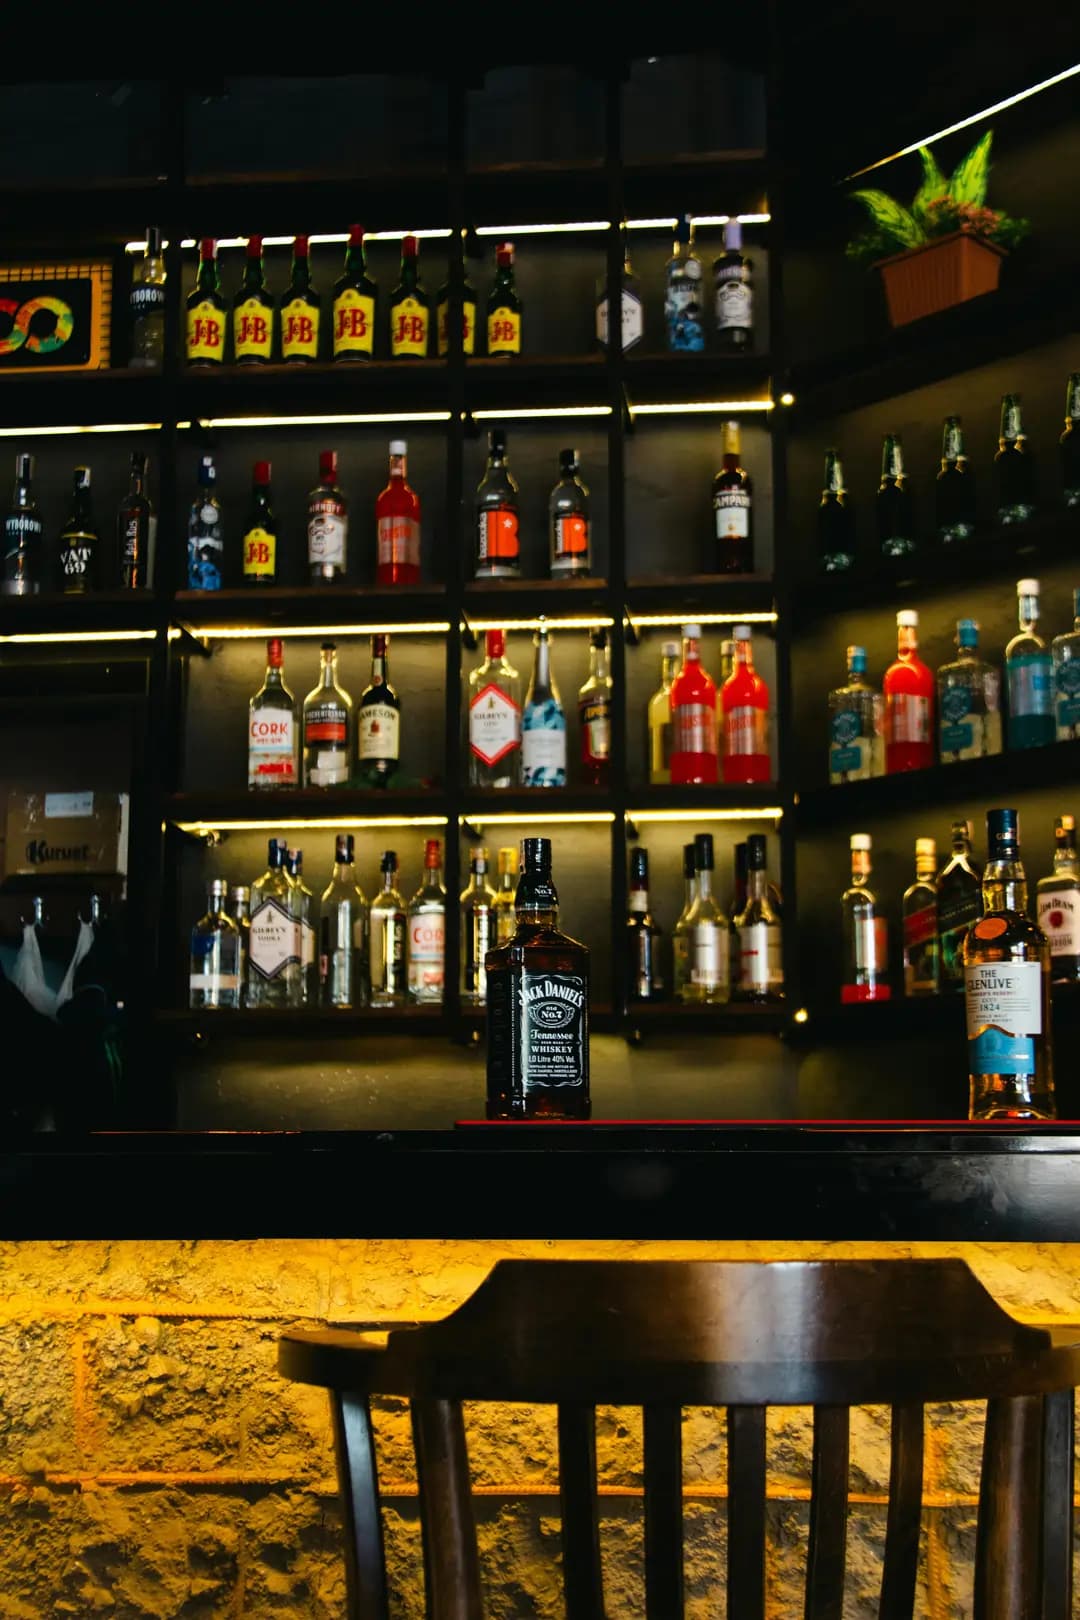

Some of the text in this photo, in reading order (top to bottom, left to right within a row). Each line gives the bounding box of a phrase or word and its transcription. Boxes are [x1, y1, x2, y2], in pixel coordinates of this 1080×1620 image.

[191, 319, 220, 347] J&B
[237, 316, 267, 344] J&B
[283, 316, 313, 345] J&B
[336, 308, 367, 340] J&B
[394, 315, 425, 343] J&B
[491, 321, 514, 343] J&B
[60, 547, 92, 565] VAT
[245, 542, 270, 564] J&B
[64, 561, 86, 575] 69
[250, 721, 288, 738] CORK
[980, 969, 997, 978] THE
[517, 980, 585, 1008] JACK DANIEL'S
[541, 1010, 562, 1019] No.7
[980, 1003, 1000, 1011] 1824
[530, 1029, 574, 1040] Tennessee
[531, 1045, 573, 1053] WHISKEY
